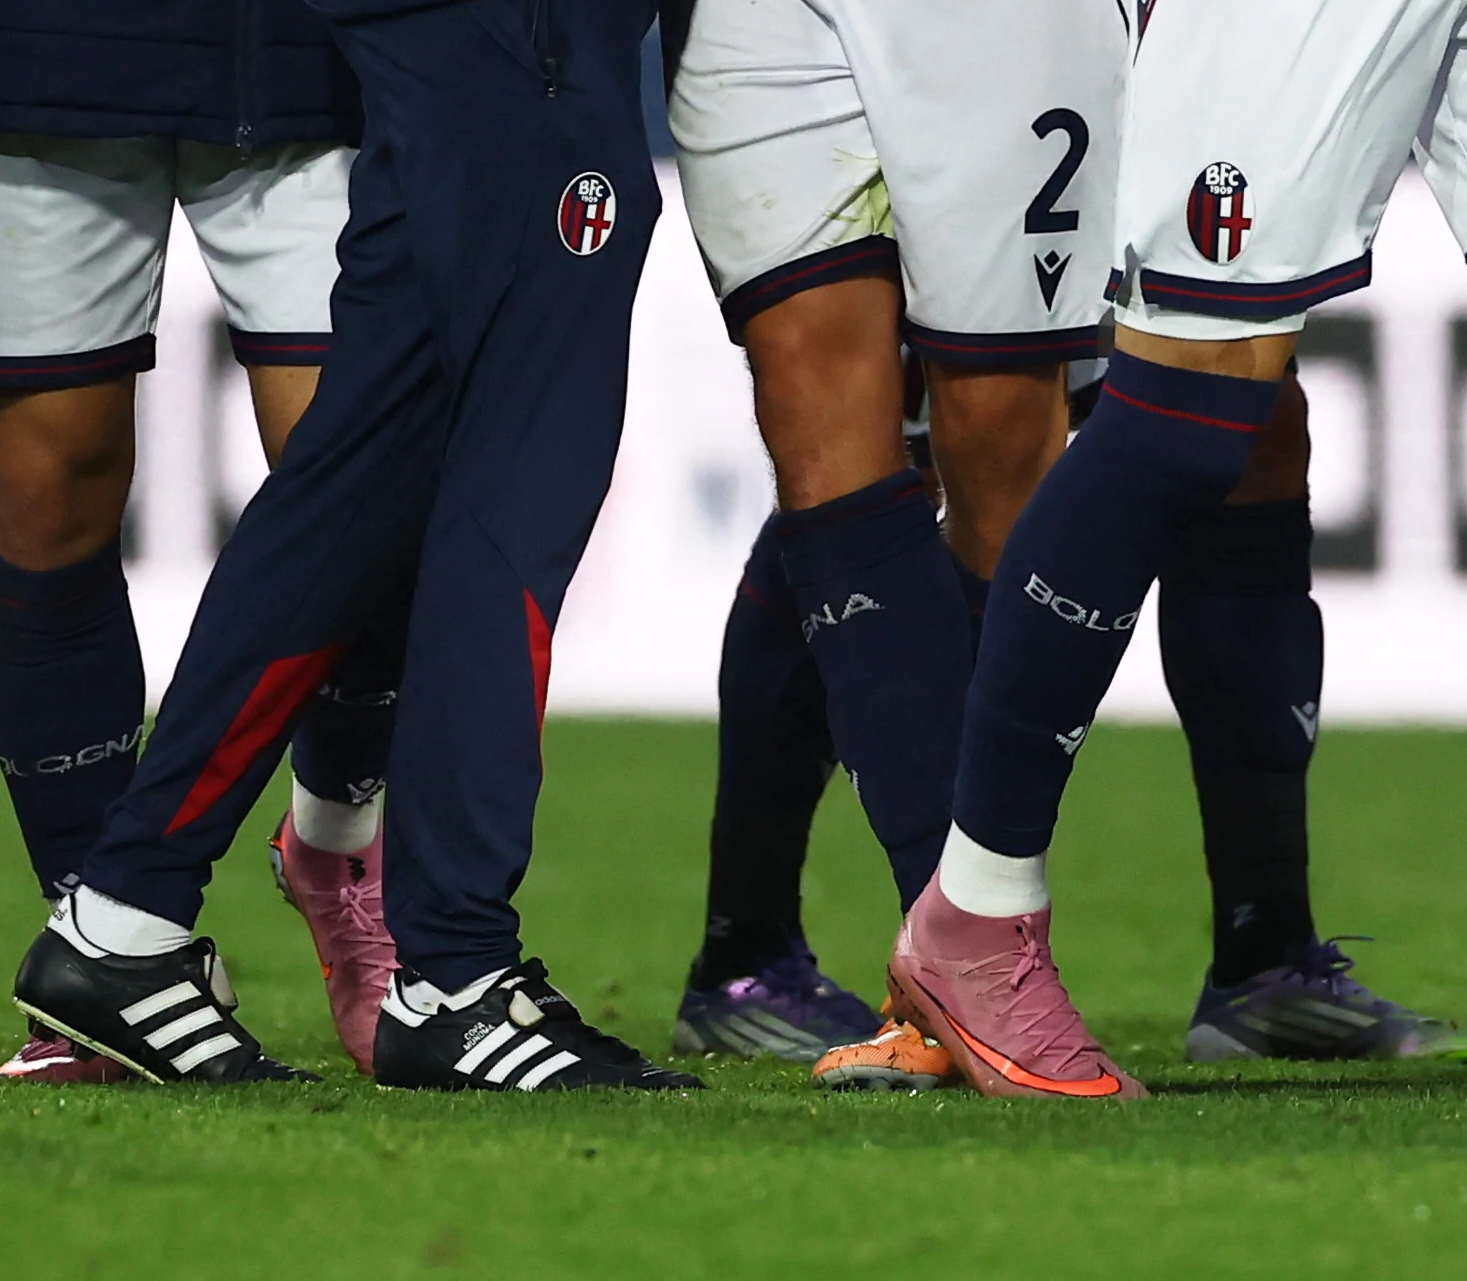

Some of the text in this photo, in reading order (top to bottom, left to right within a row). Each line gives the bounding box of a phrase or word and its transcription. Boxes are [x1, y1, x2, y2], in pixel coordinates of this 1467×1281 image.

[1023, 108, 1090, 235] 2
[1205, 164, 1239, 187] BFC
[578, 179, 605, 198] BFC
[1209, 185, 1233, 195] 1909
